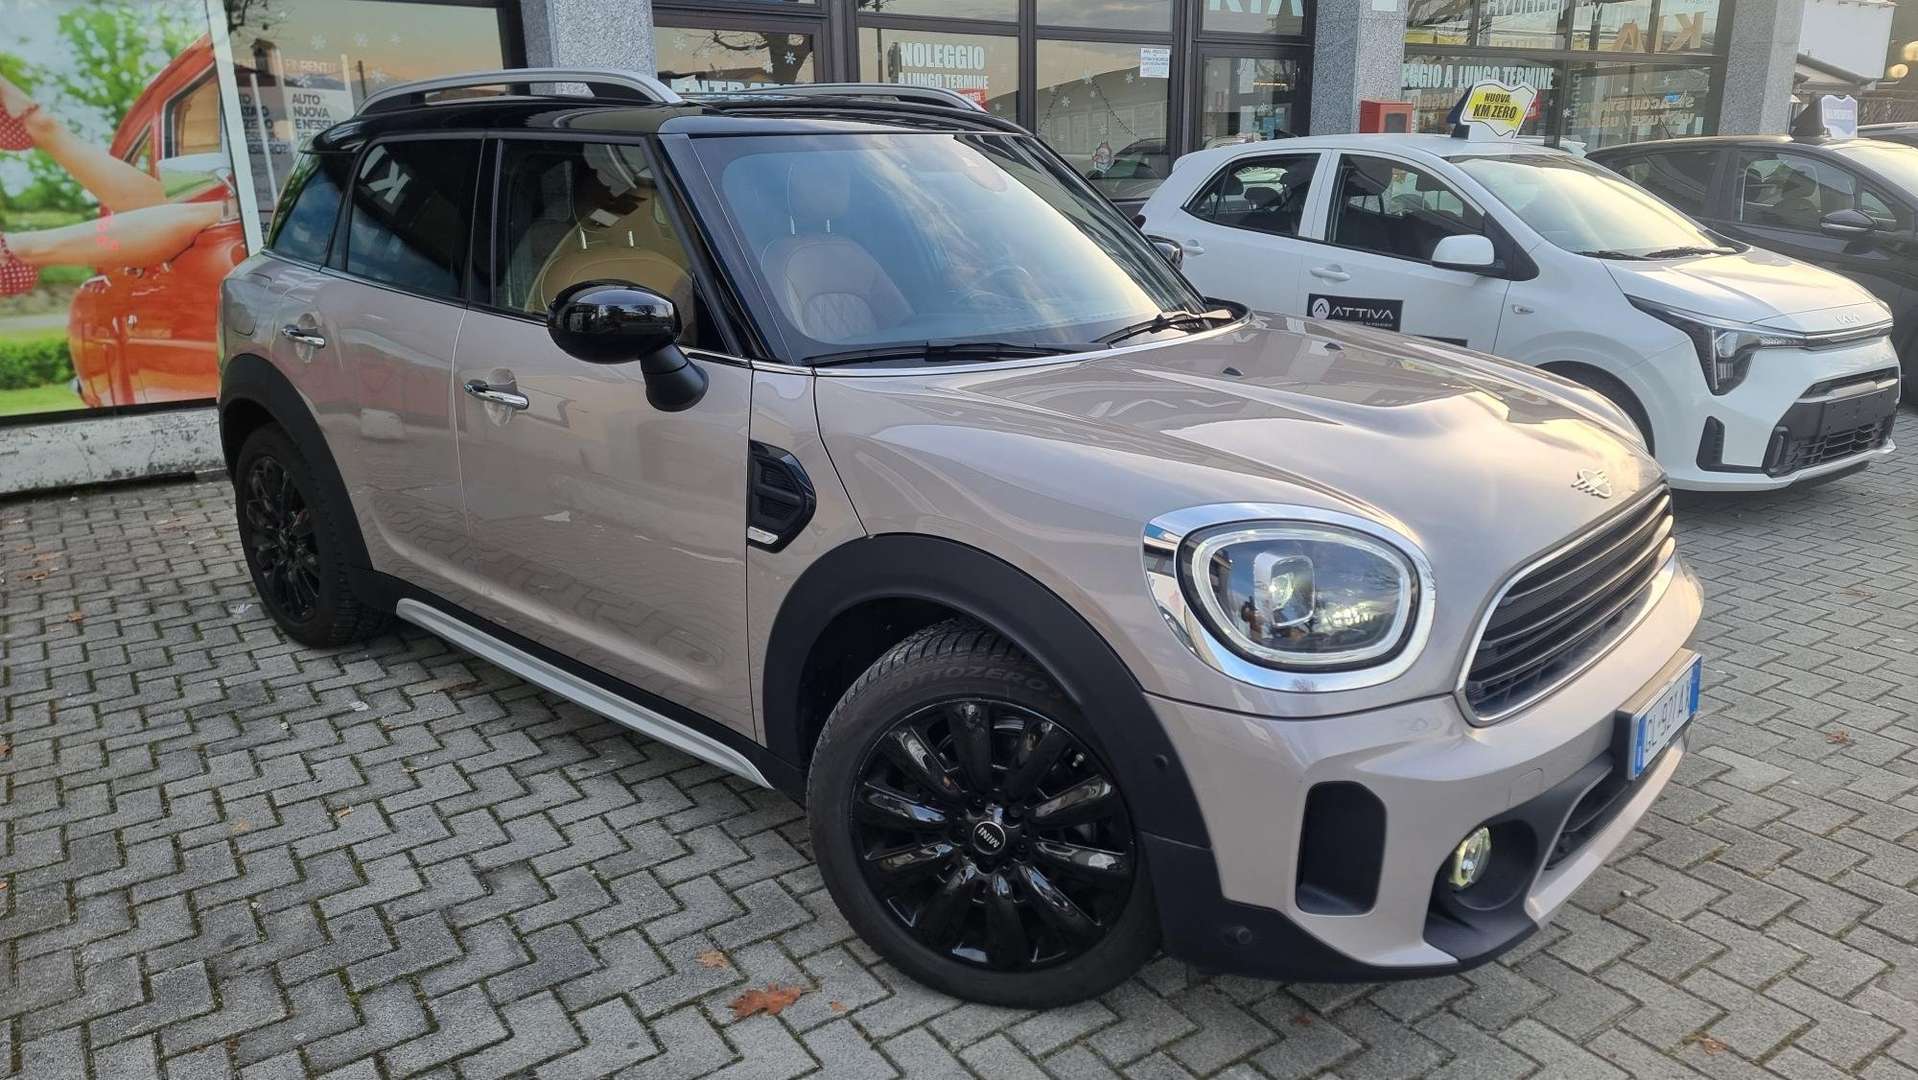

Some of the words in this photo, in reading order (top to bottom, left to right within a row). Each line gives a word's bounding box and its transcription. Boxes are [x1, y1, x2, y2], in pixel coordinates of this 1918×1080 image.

[901, 42, 985, 70] NOLEGGIO
[898, 72, 905, 85] A
[907, 72, 943, 88] LUNGO
[944, 74, 989, 91] TERMINE
[1444, 64, 1454, 88] A
[1458, 64, 1501, 89] LUNGO
[1502, 66, 1555, 90] TERMINE
[292, 93, 321, 105] AUTO
[1484, 92, 1511, 104] NUOVA
[293, 107, 330, 118] NUOVA
[1472, 104, 1490, 118] KM
[1490, 105, 1517, 120] ZERO
[1332, 306, 1394, 320] ATTIVA
[977, 826, 1000, 849] MINI
